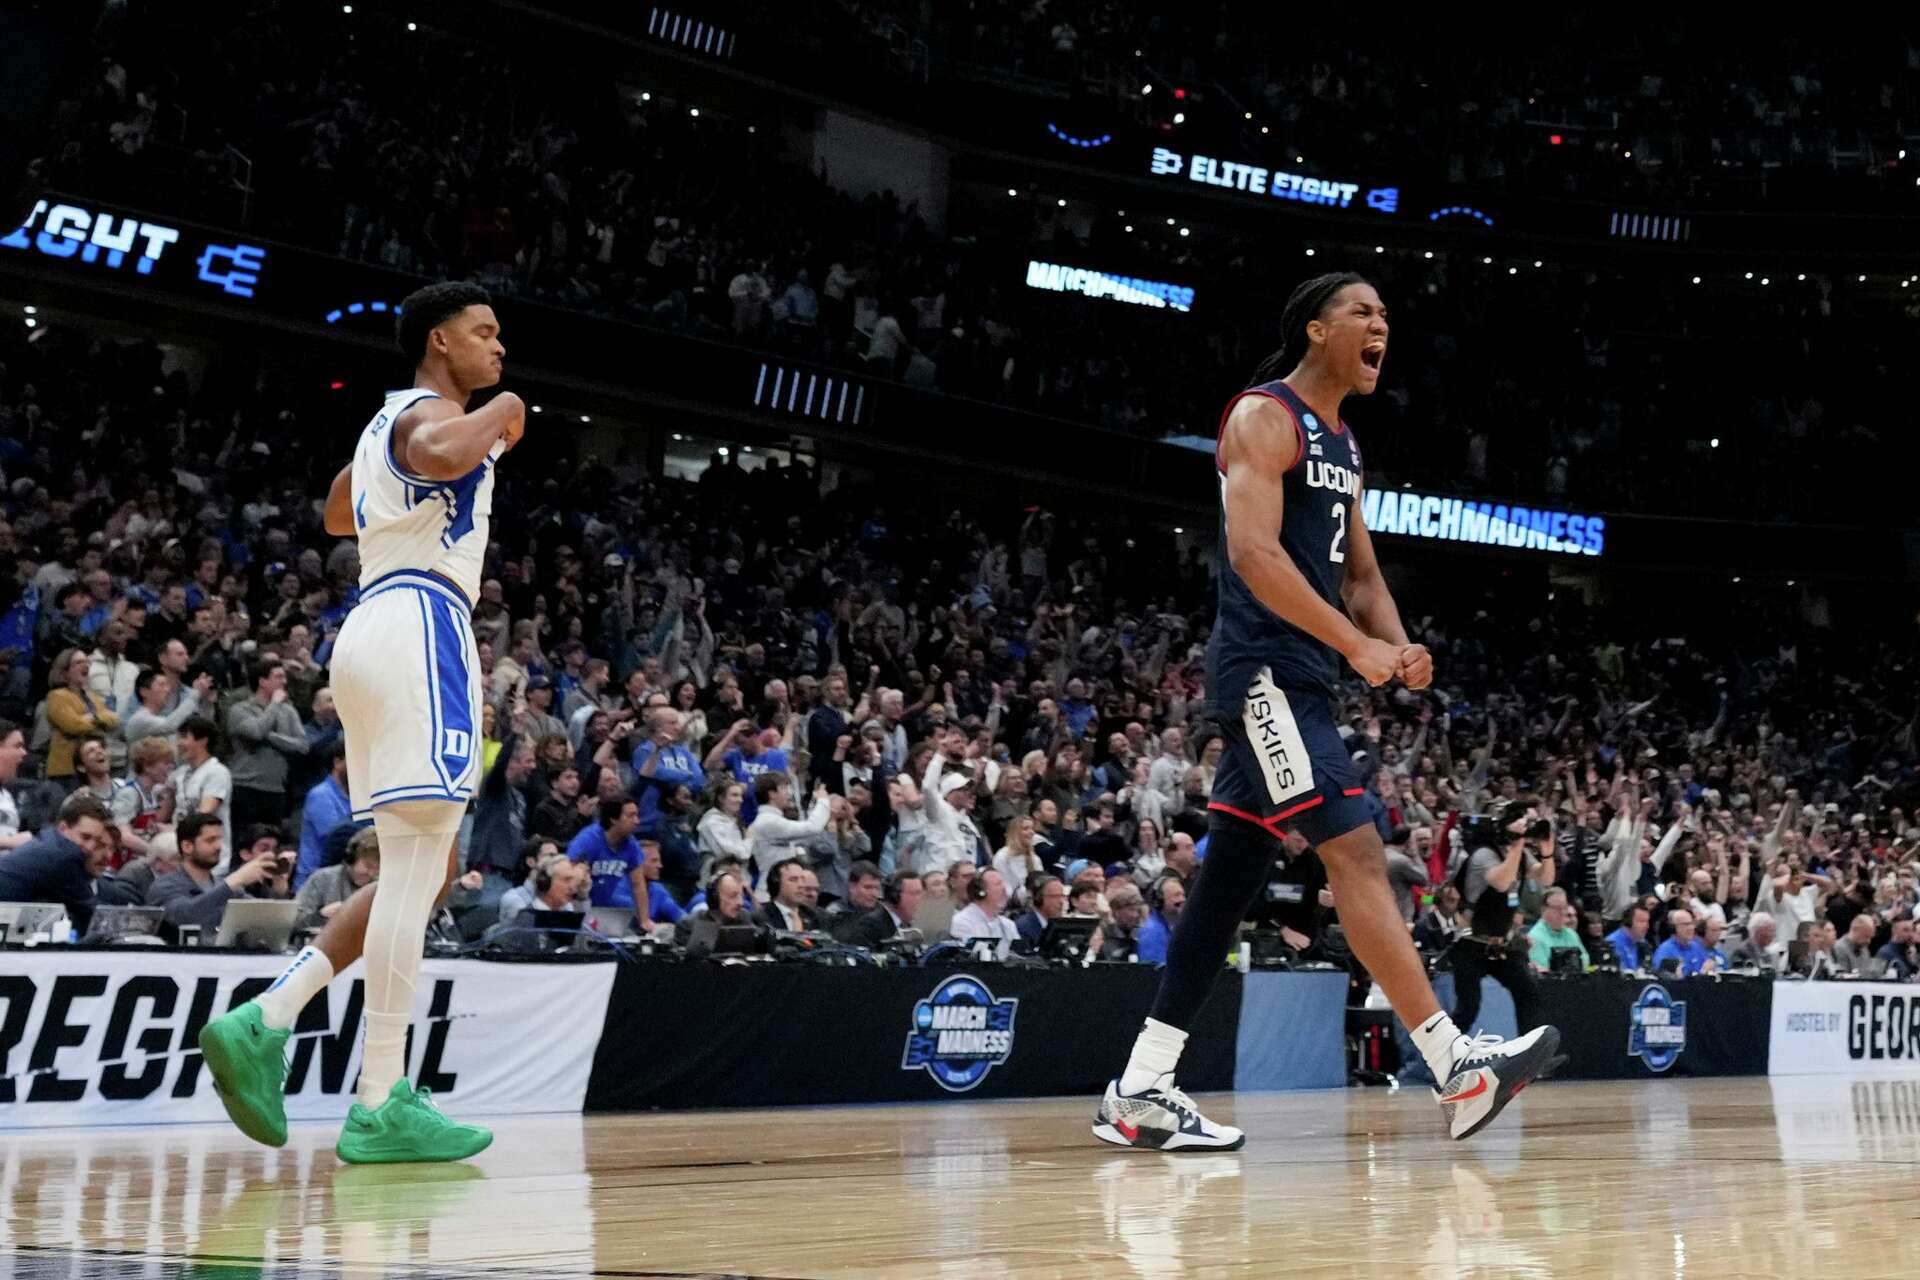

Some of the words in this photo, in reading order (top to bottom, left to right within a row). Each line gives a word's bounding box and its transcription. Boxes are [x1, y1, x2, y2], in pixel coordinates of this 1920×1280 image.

[1189, 155, 1268, 194] ELITE
[1271, 172, 1359, 208] EIGHT
[1329, 502, 1345, 563] 2
[443, 728, 470, 758] D
[0, 975, 460, 1103] REGINL
[1849, 994, 1920, 1060] GEOR
